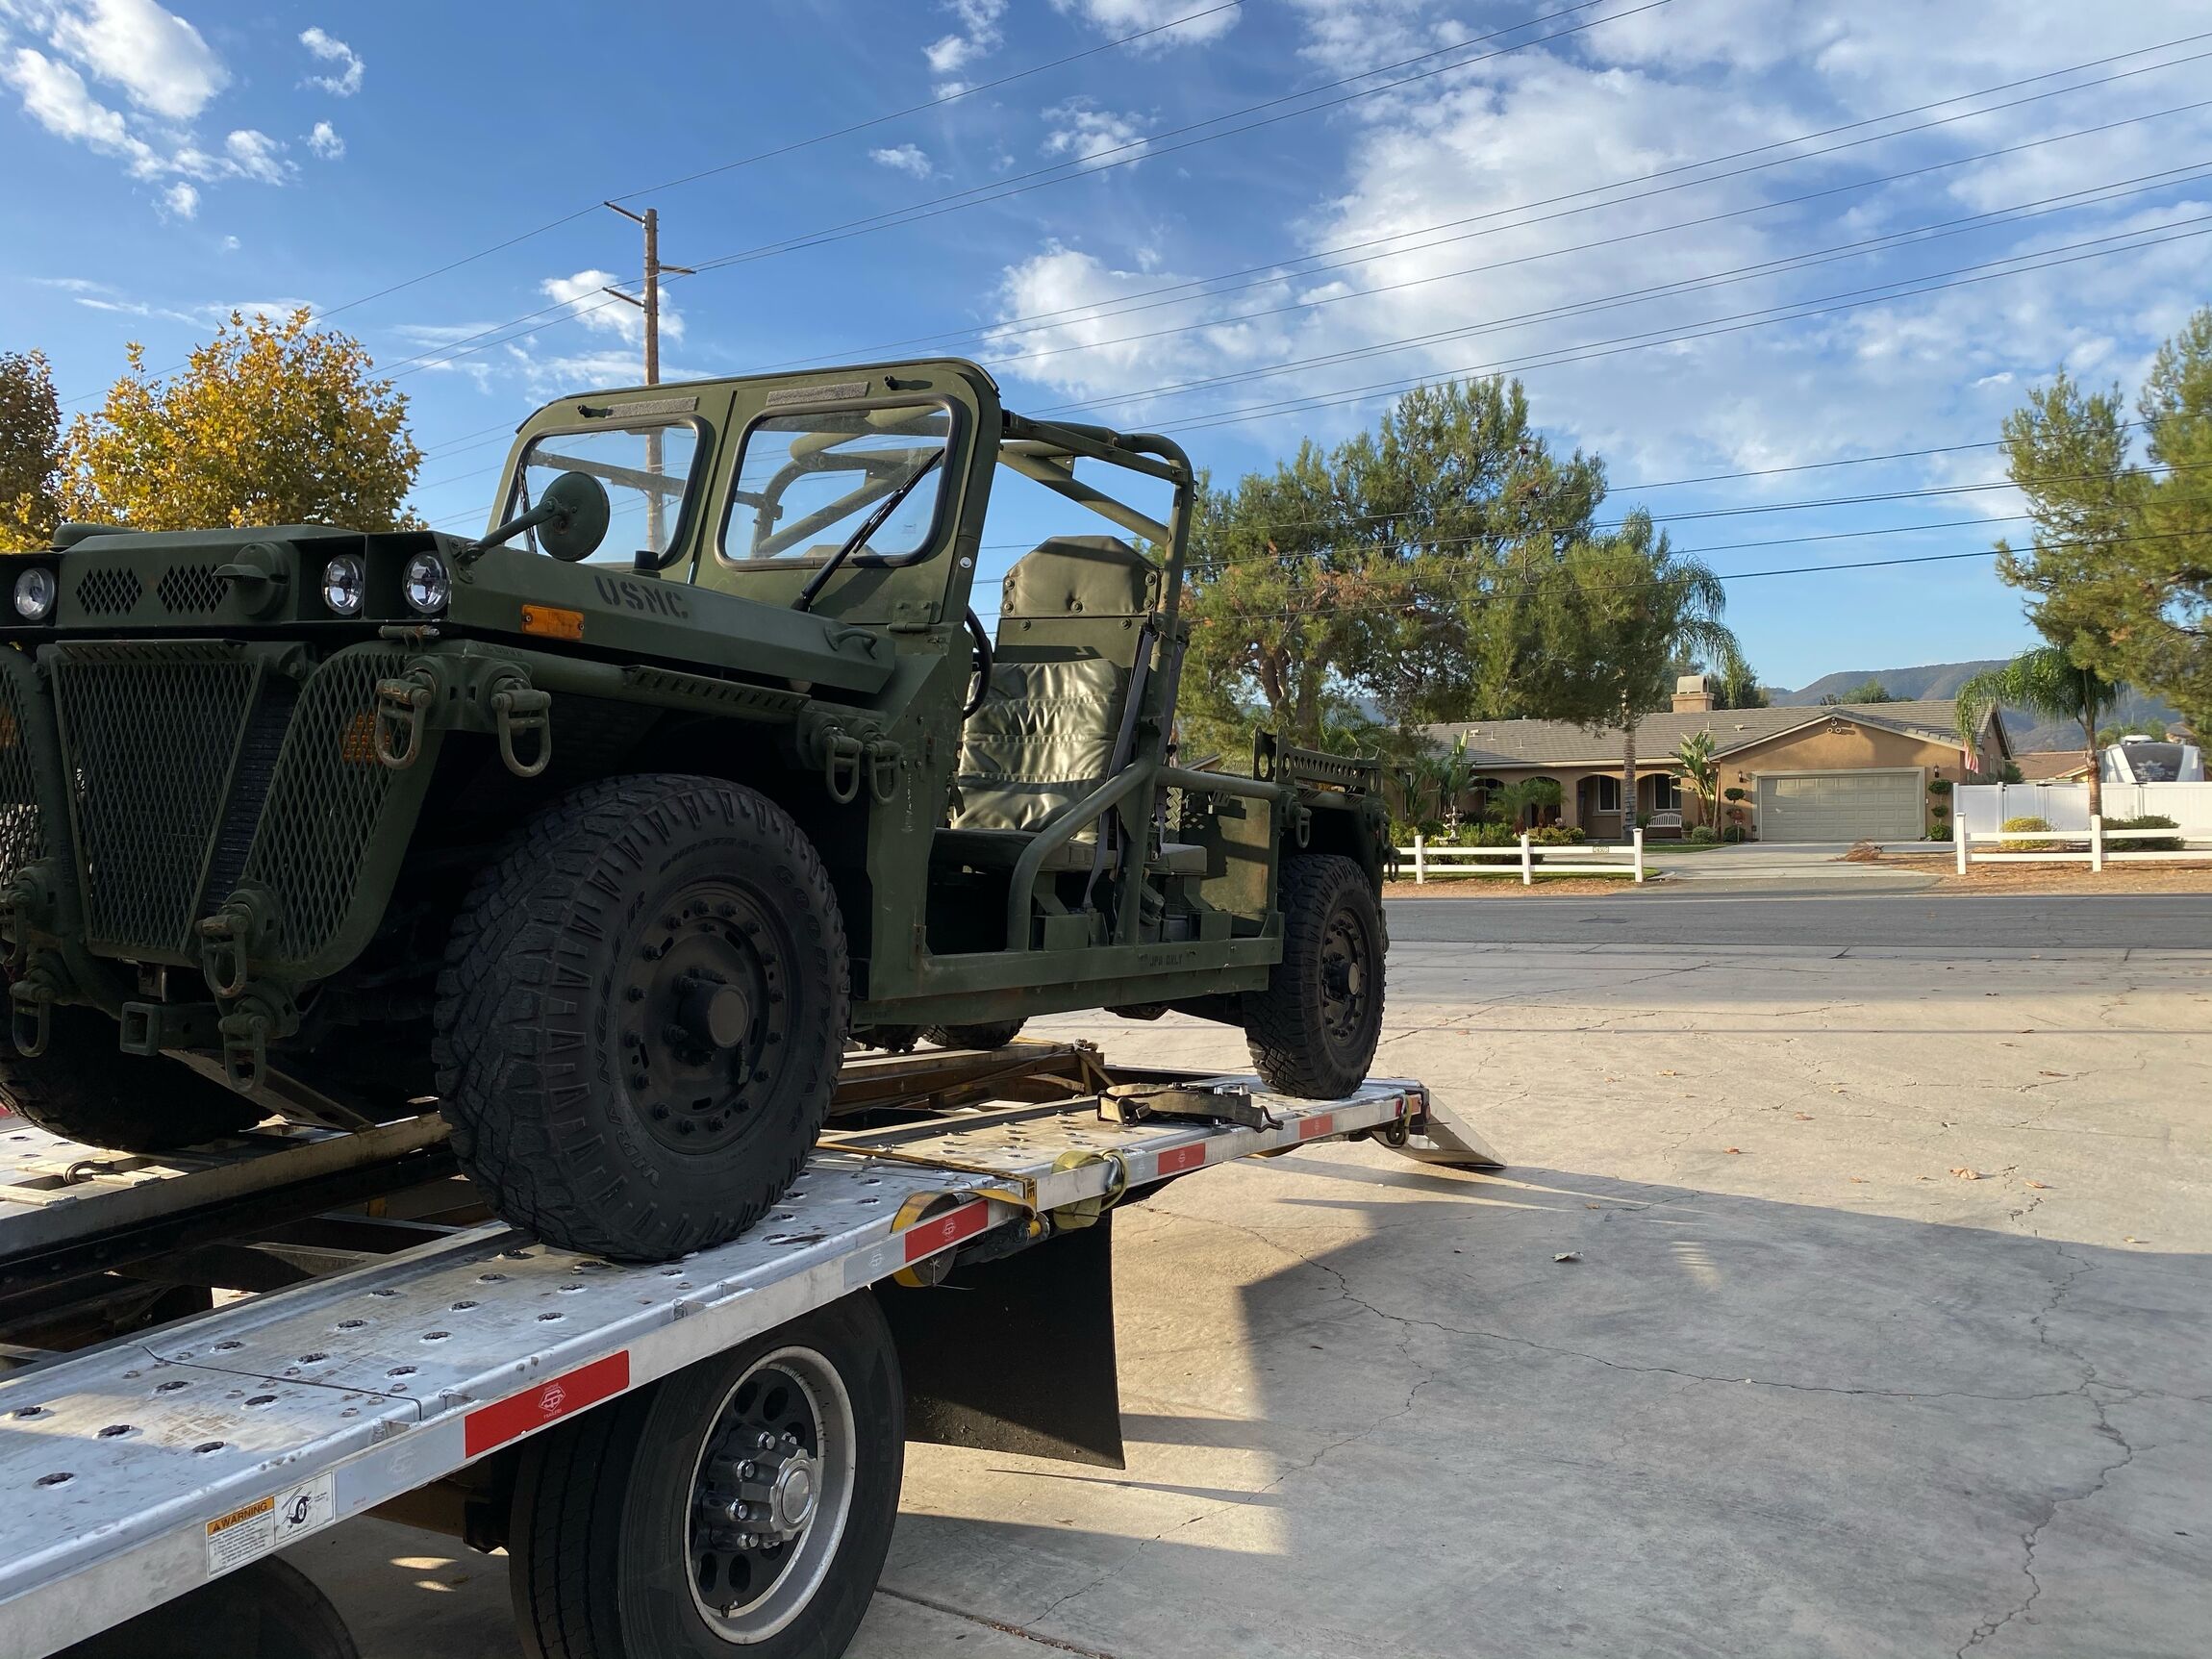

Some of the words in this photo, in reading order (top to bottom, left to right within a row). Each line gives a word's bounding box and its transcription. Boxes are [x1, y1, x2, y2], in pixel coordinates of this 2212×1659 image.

[594, 575, 689, 618] USMC
[595, 890, 662, 1189] WRANGLER
[770, 864, 828, 1137] GOODYEAR
[220, 1501, 267, 1528] WARNING
